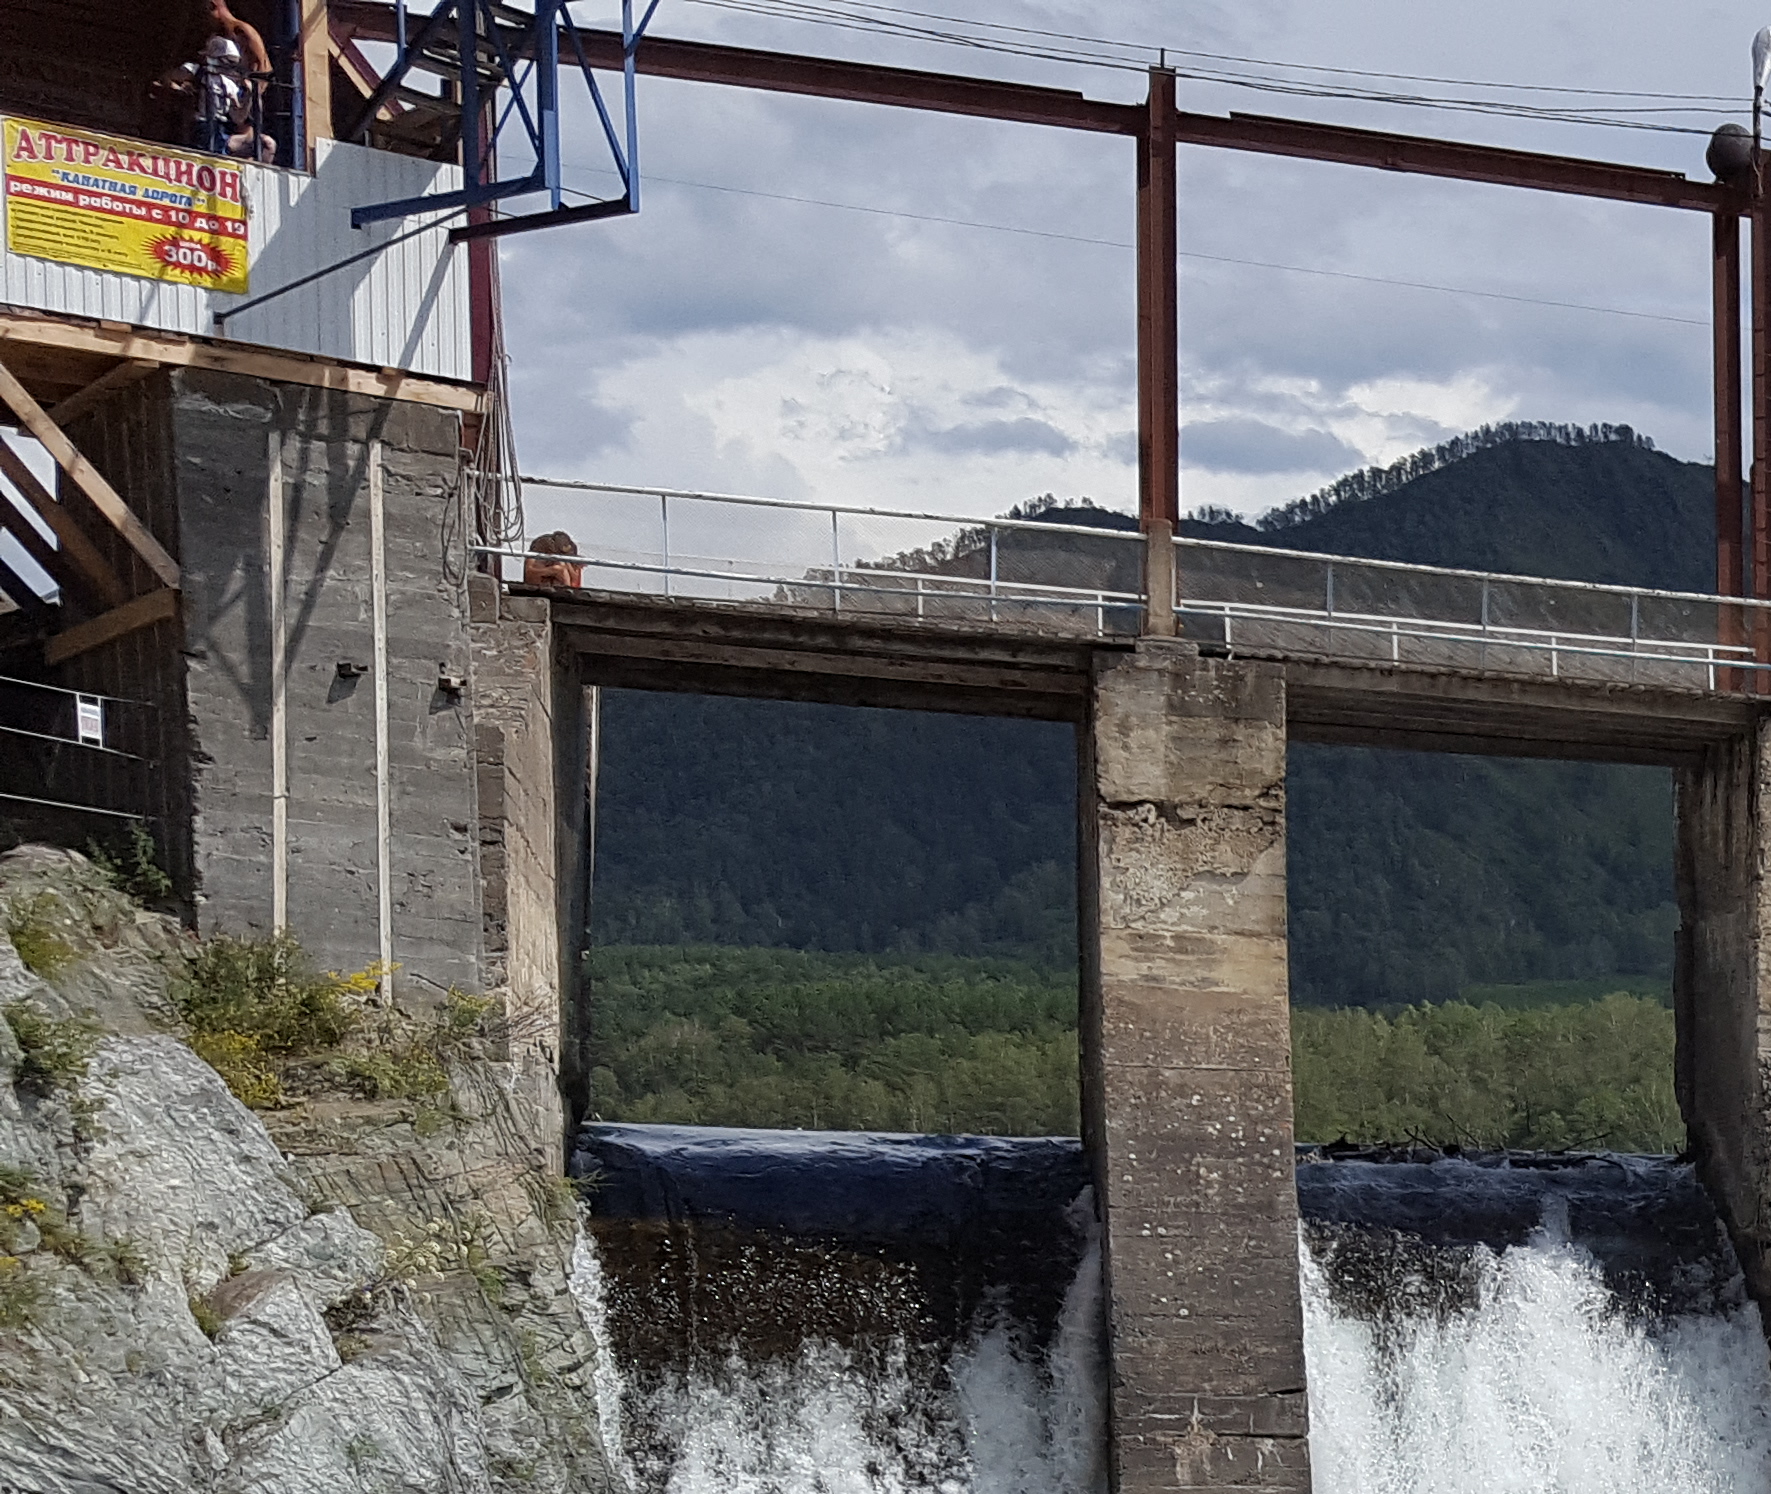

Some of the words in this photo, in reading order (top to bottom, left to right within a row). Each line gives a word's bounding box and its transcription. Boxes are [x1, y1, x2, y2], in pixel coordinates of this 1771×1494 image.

[12, 128, 241, 204] АТТРАКЦИОН
[9, 180, 75, 203] режим
[77, 193, 146, 216] работы
[150, 209, 163, 220] с
[168, 210, 191, 224] 10
[194, 217, 219, 230] до
[224, 220, 245, 235] 19
